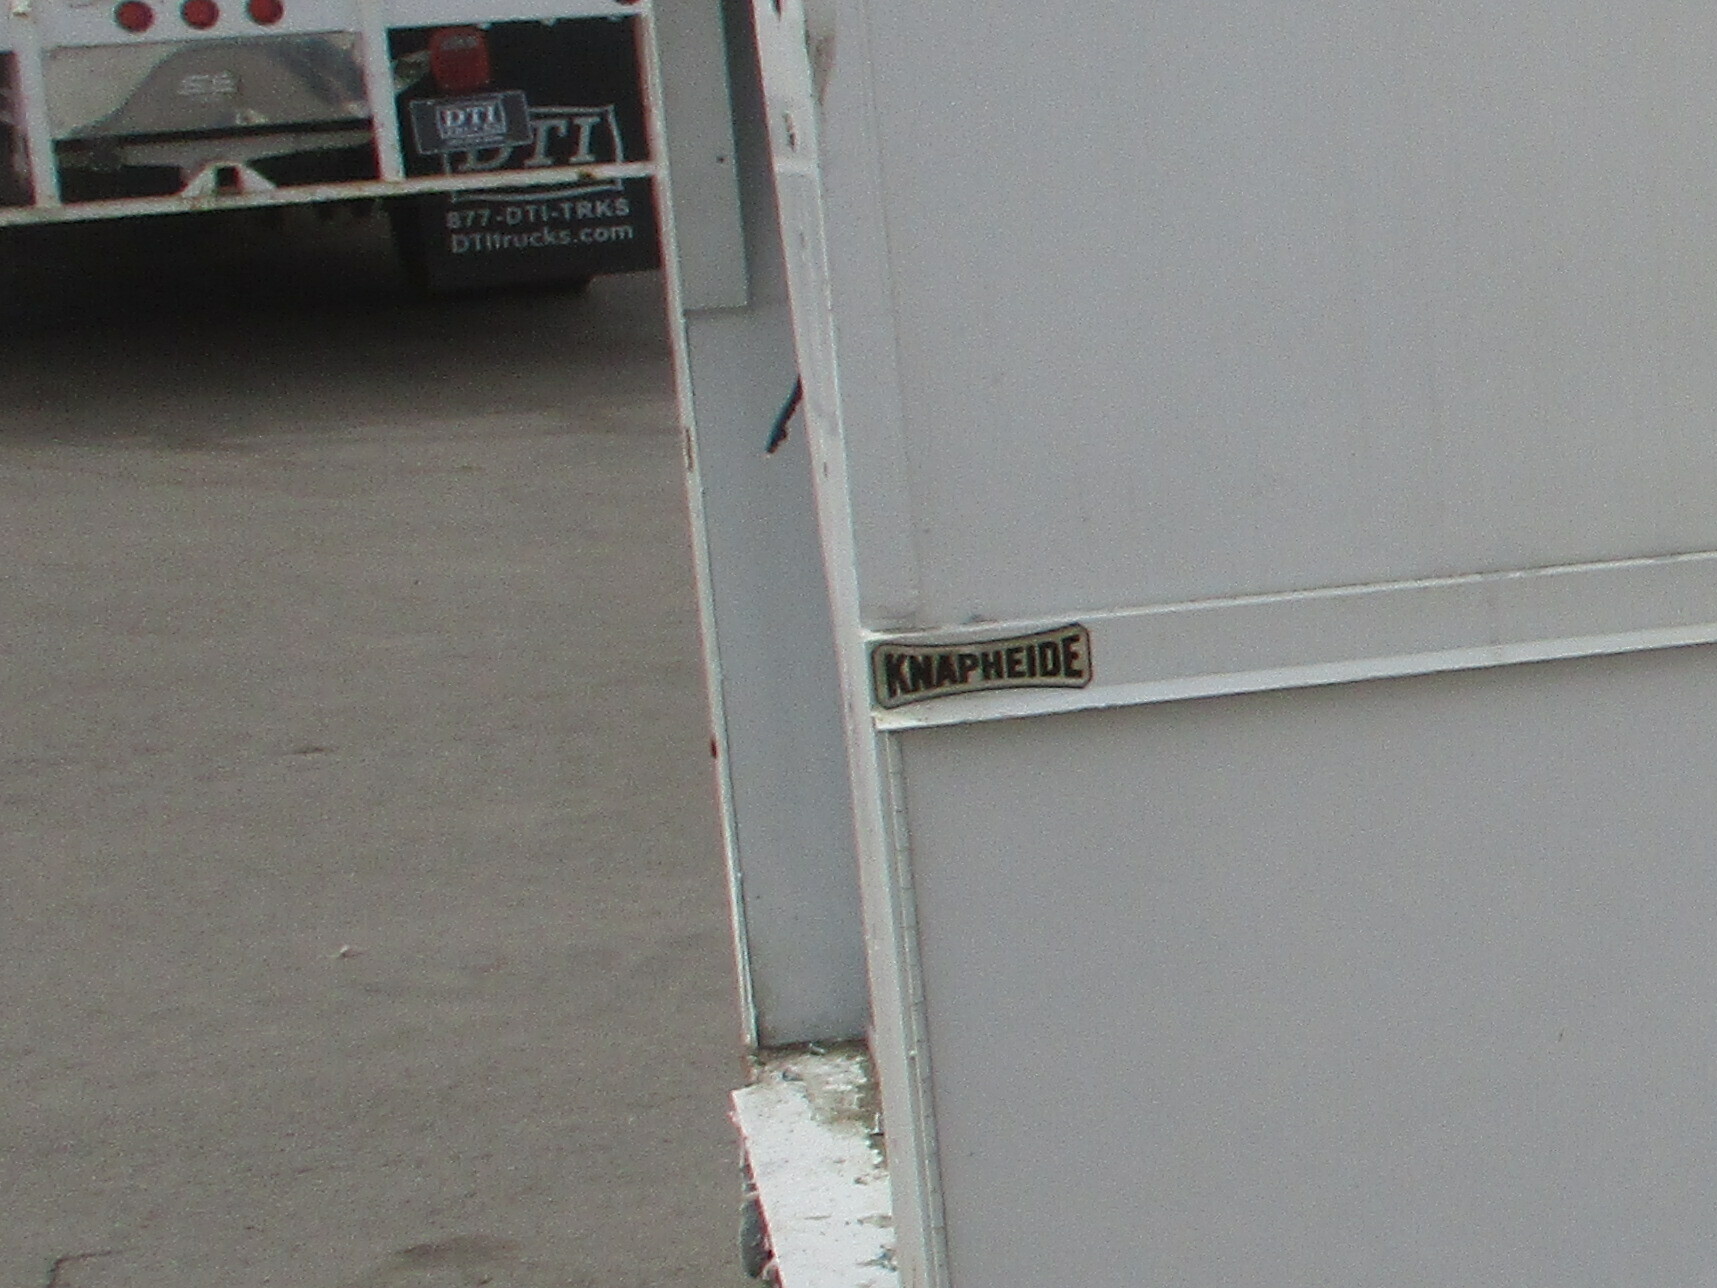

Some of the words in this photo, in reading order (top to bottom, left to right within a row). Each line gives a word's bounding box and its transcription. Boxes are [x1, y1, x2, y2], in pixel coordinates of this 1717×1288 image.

[444, 105, 499, 127] DTI
[447, 198, 630, 229] 877-DTI-TRKS
[884, 634, 1083, 698] KNAPHEIDE
